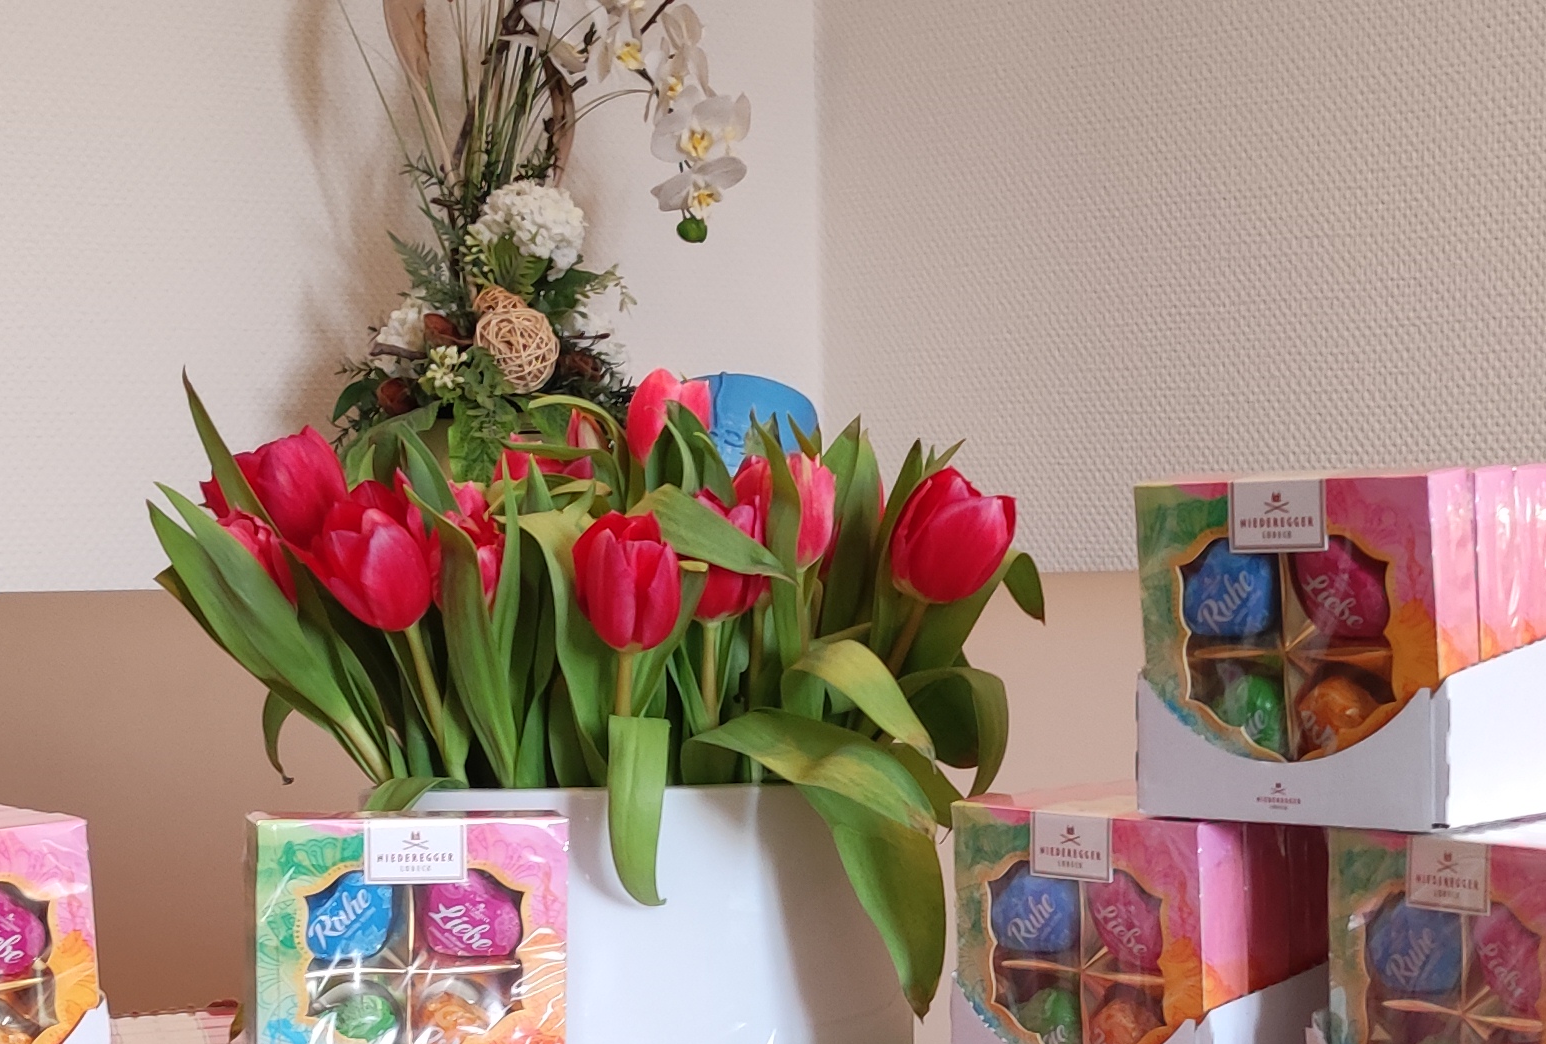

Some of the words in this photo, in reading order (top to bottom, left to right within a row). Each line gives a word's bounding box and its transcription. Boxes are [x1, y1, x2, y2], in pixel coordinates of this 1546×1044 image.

[1240, 516, 1315, 529] NIEDEREGGER
[1197, 571, 1254, 634] Ruhe
[1304, 574, 1364, 629] Liebe
[376, 852, 455, 863] NIEDEREGGER
[1040, 846, 1103, 862] NIEDEREGGER
[307, 887, 372, 950] Ruhe
[428, 902, 493, 952] Liebe
[1007, 893, 1056, 945] Ruhe
